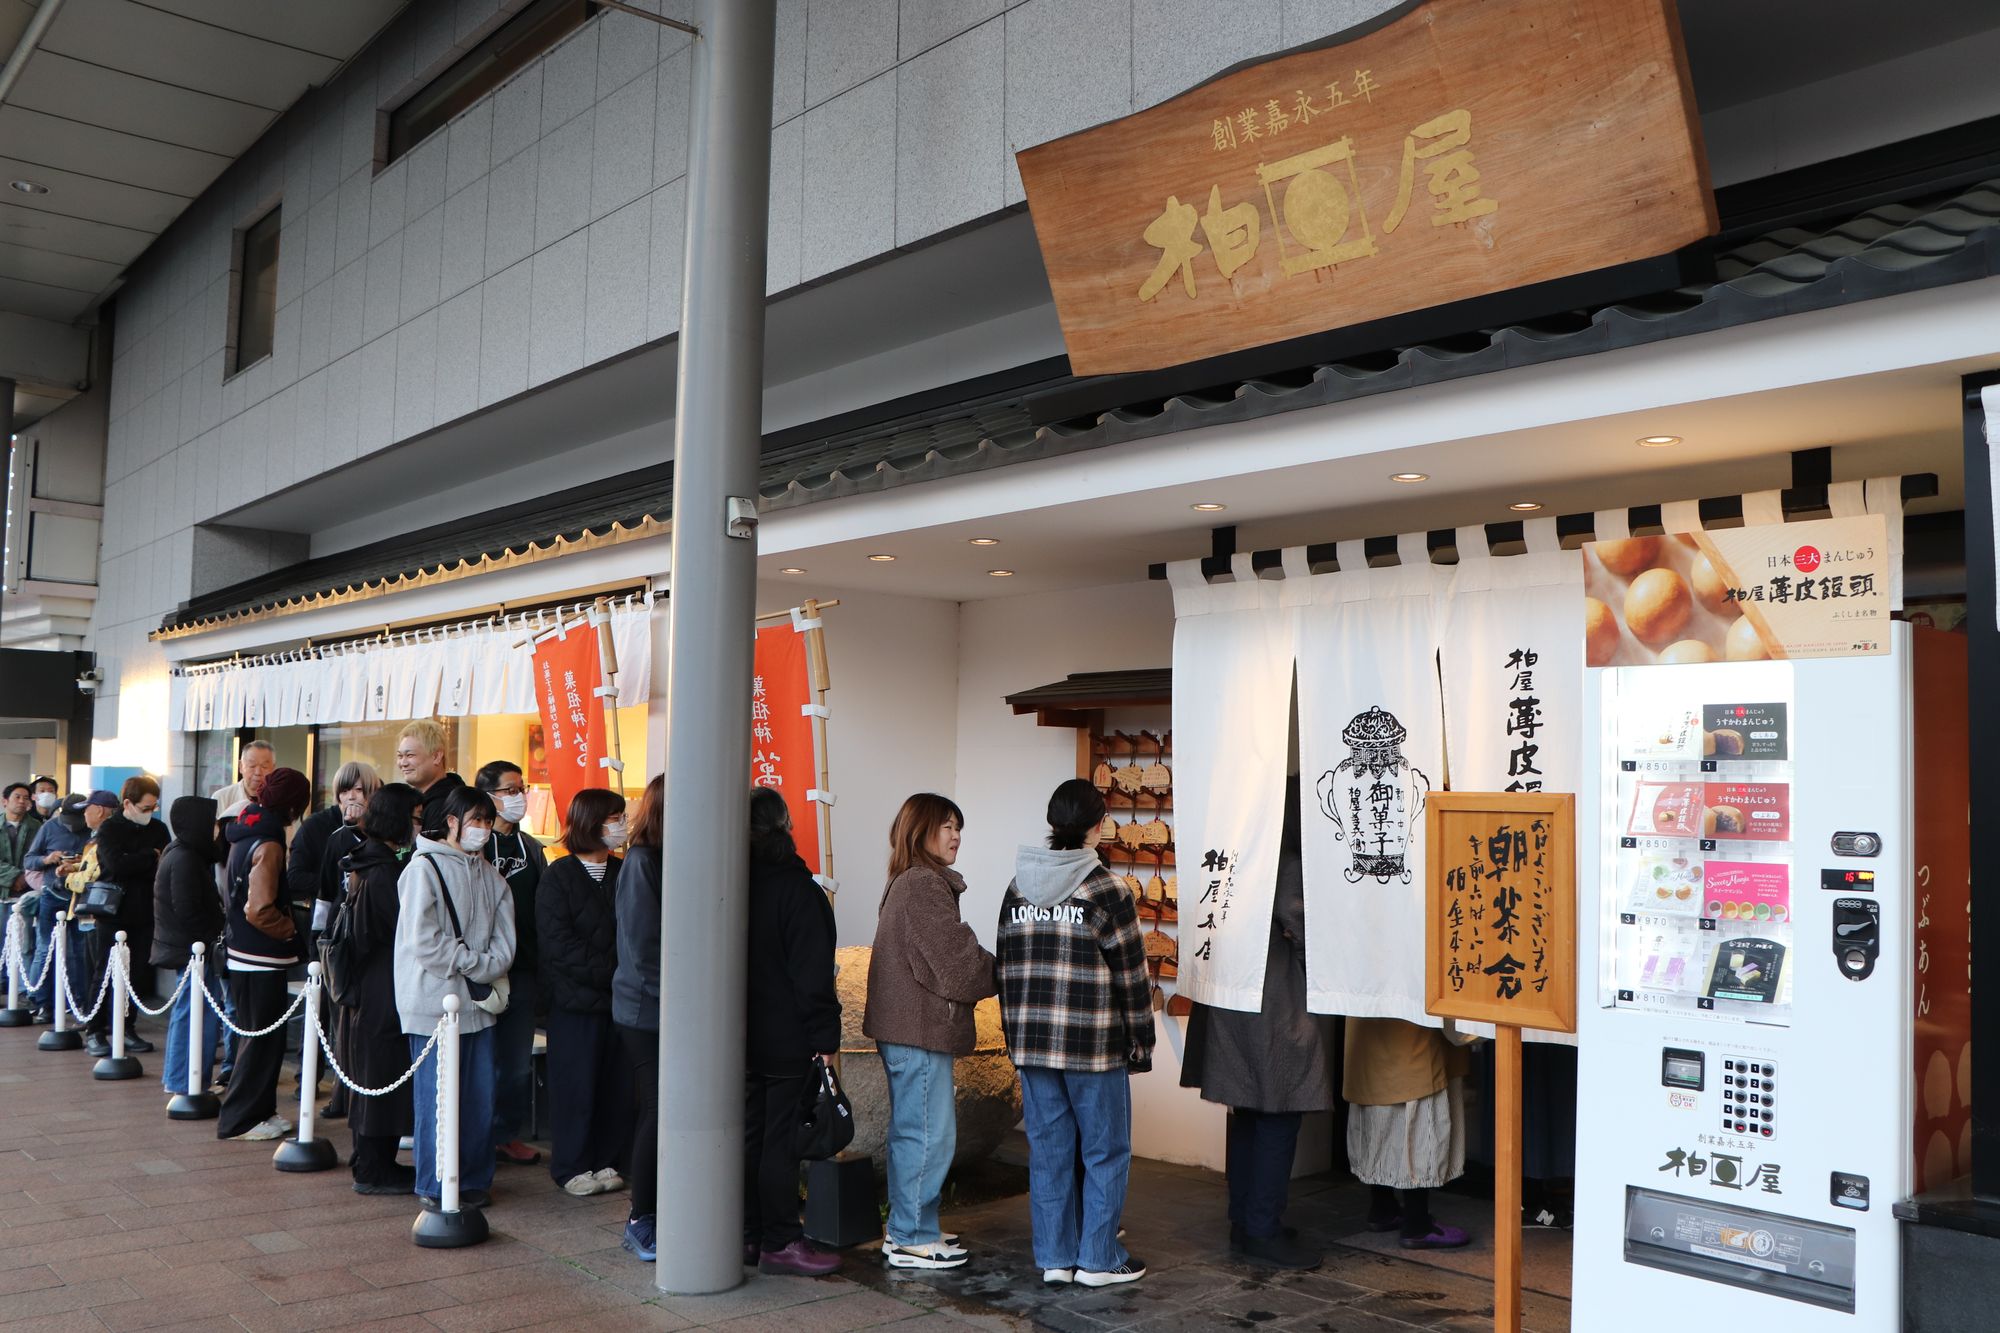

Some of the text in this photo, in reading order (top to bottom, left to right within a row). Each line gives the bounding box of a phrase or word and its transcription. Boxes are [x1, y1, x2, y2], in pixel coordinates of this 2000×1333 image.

[1209, 68, 1381, 152] 創業嘉永五年
[1137, 108, 1500, 302] 柏屋
[1768, 547, 1874, 569] 日本三大まんじゅう
[1715, 718, 1775, 727] うすかわまんじゅう
[1638, 762, 1668, 771] ¥850
[1717, 796, 1777, 805] うすかわまんじゅう
[1365, 781, 1394, 856] 御菓子
[1638, 840, 1668, 849] ¥850
[1011, 904, 1085, 925] LOGOS DAYS
[1195, 849, 1229, 961] 柏屋本店
[1483, 825, 1528, 1000] 朝茶会
[1446, 866, 1466, 992] 柏屋本店
[1638, 917, 1667, 926] ¥970
[1917, 865, 1930, 1017] つぶあん
[1635, 993, 1665, 1004] ¥810
[1697, 1133, 1756, 1150] 創業嘉永五年
[1659, 1146, 1783, 1195] 柏屋
